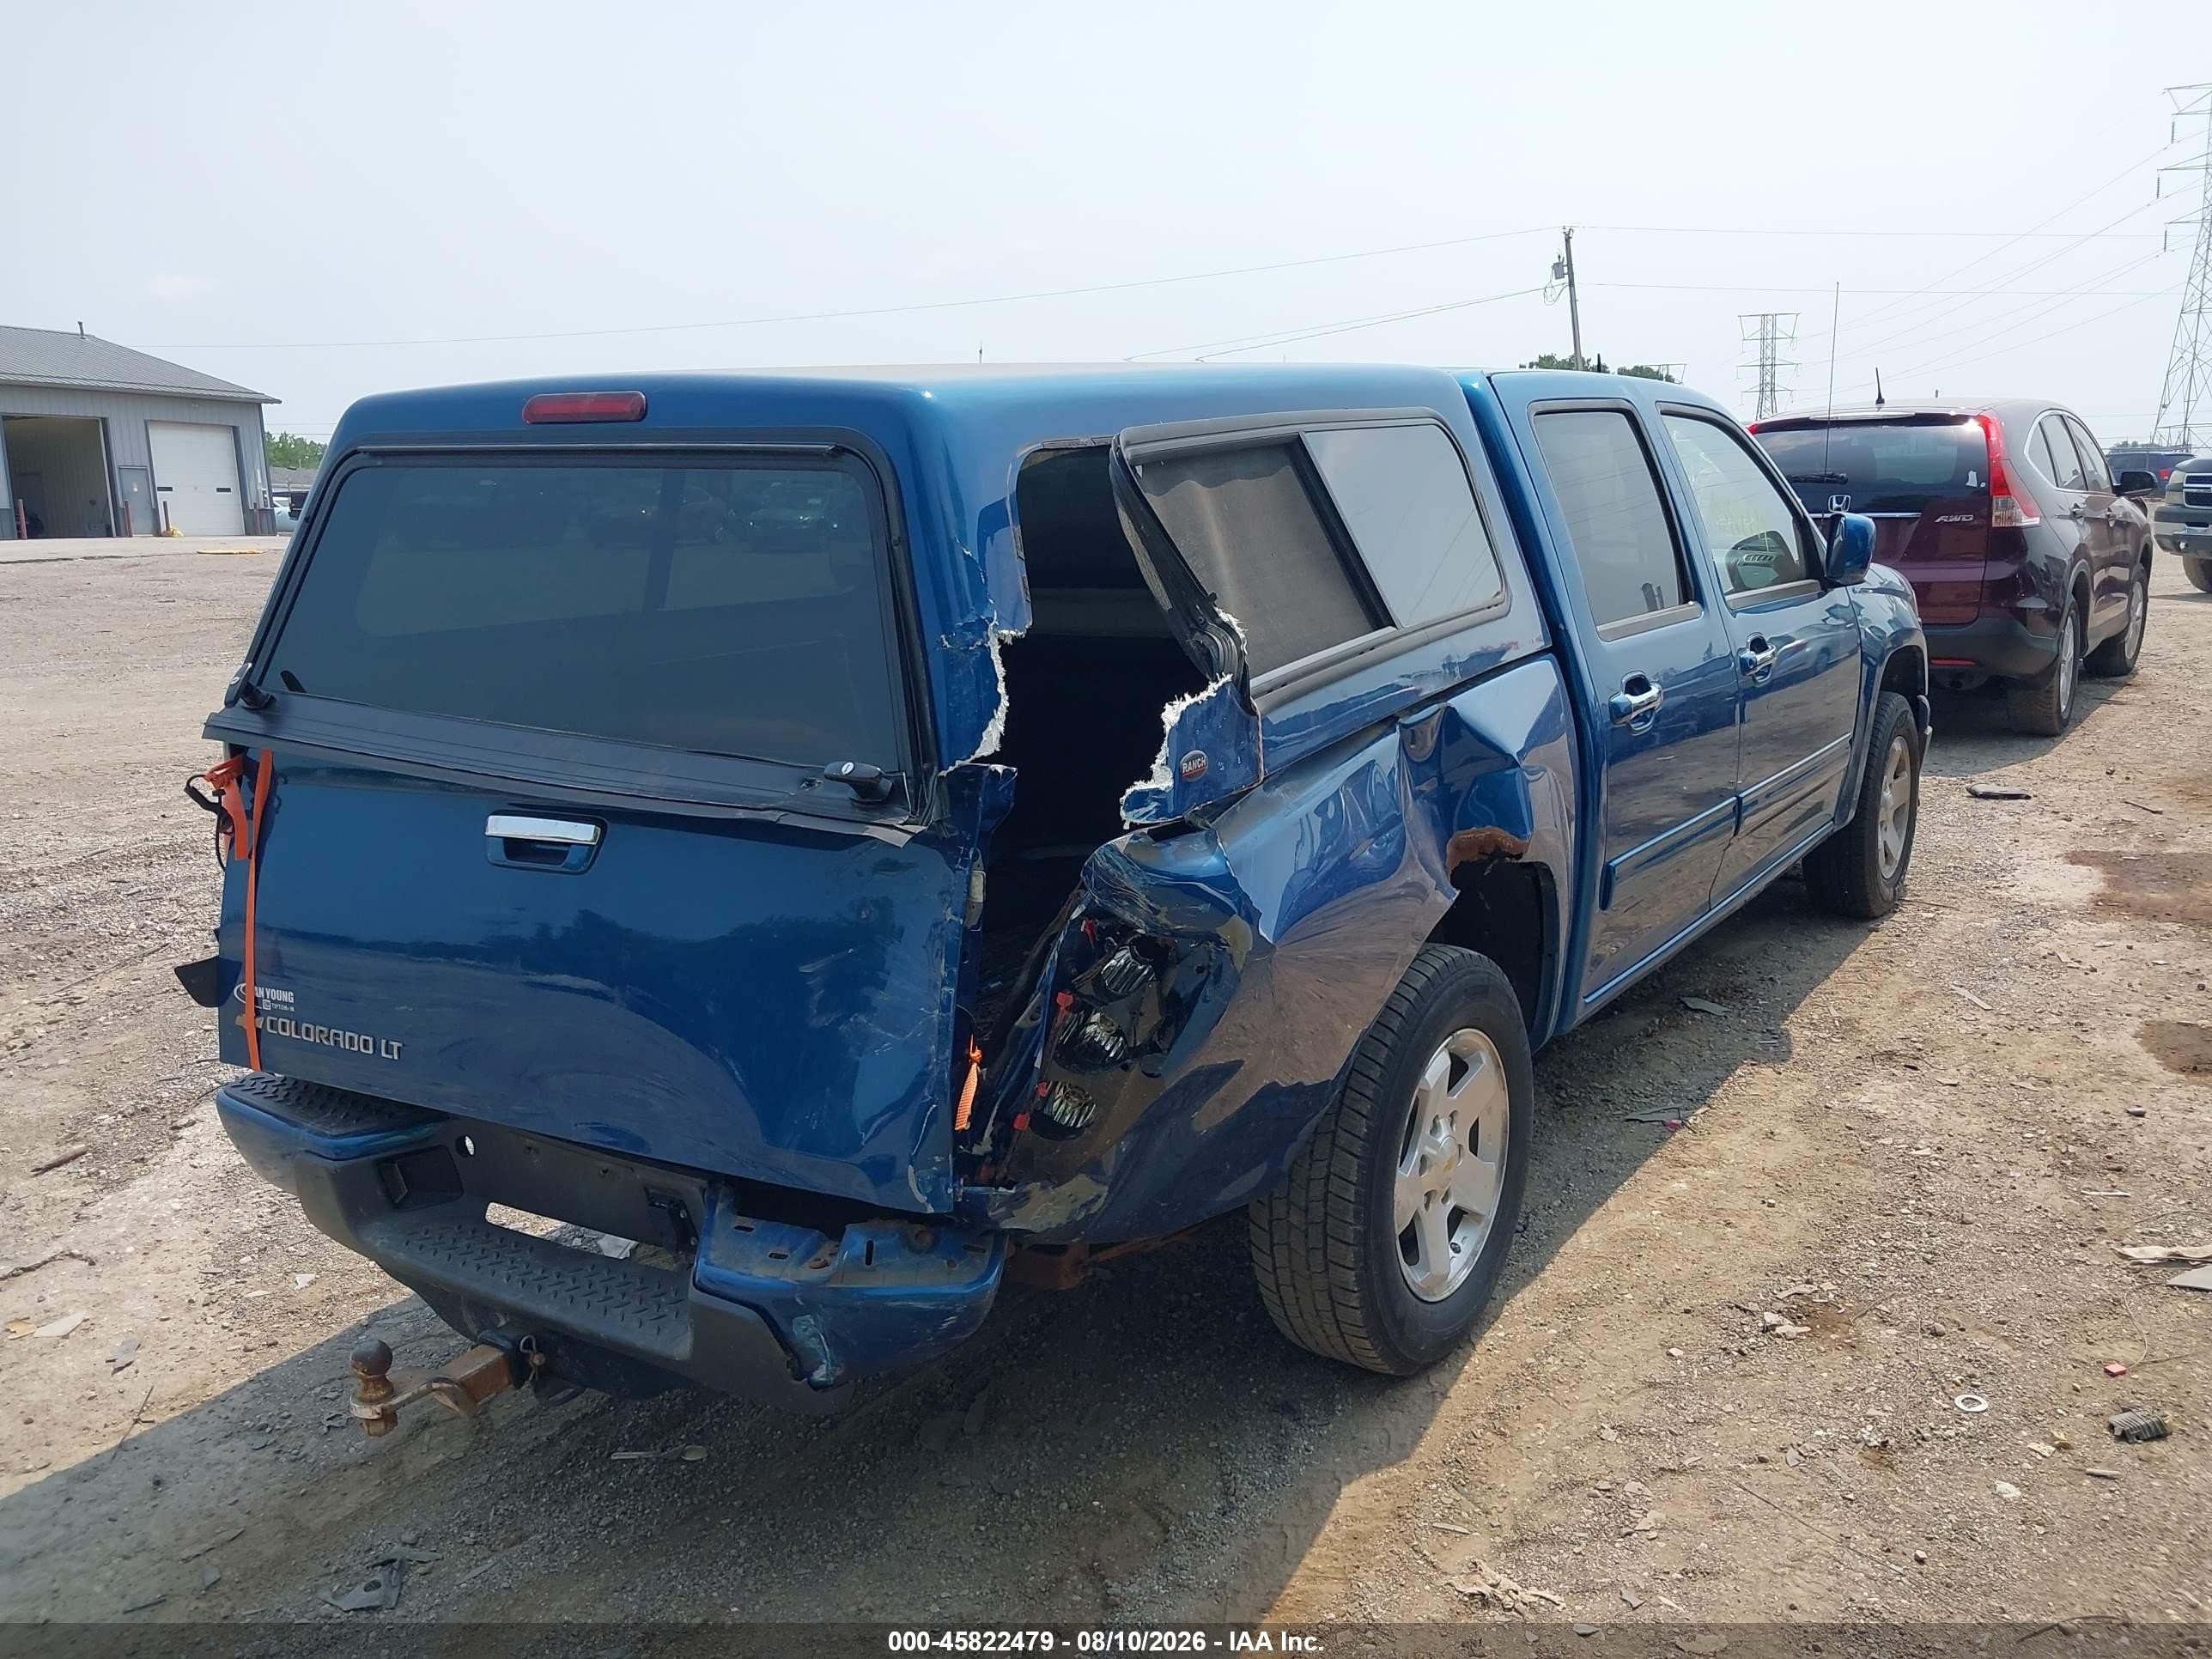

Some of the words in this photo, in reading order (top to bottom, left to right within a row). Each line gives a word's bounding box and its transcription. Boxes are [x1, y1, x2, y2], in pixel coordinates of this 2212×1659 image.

[1934, 514, 1974, 523] AWD
[1182, 756, 1206, 774] RANCH
[254, 986, 264, 999] AN
[265, 988, 295, 1003] YOUNG
[266, 1016, 374, 1054] COLORADO
[381, 1039, 404, 1060] LT
